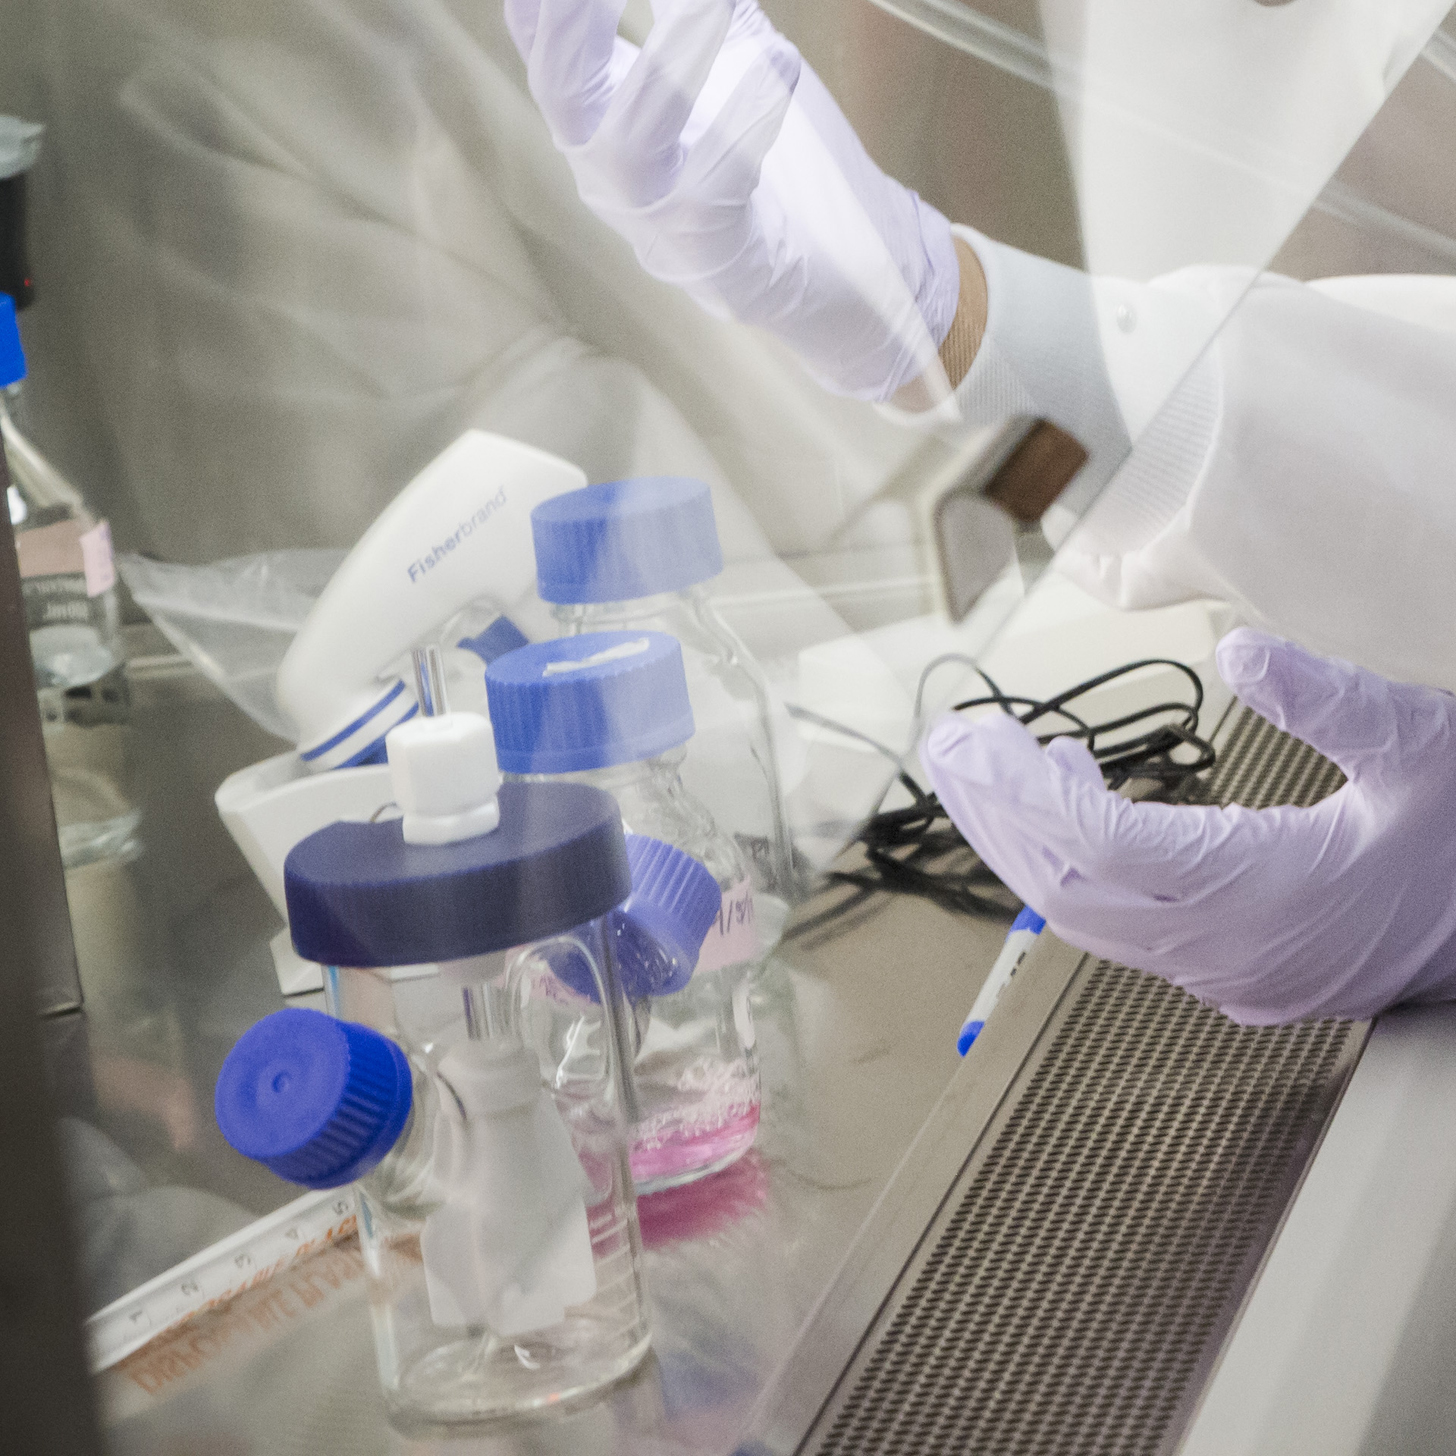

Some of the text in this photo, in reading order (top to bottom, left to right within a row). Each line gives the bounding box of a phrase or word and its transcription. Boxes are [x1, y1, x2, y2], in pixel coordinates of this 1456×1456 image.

[407, 484, 507, 583] Fisherbrand
[128, 1309, 143, 1324] 1
[180, 1280, 199, 1297] 2
[233, 1252, 252, 1270] 3
[331, 1200, 349, 1216] 5
